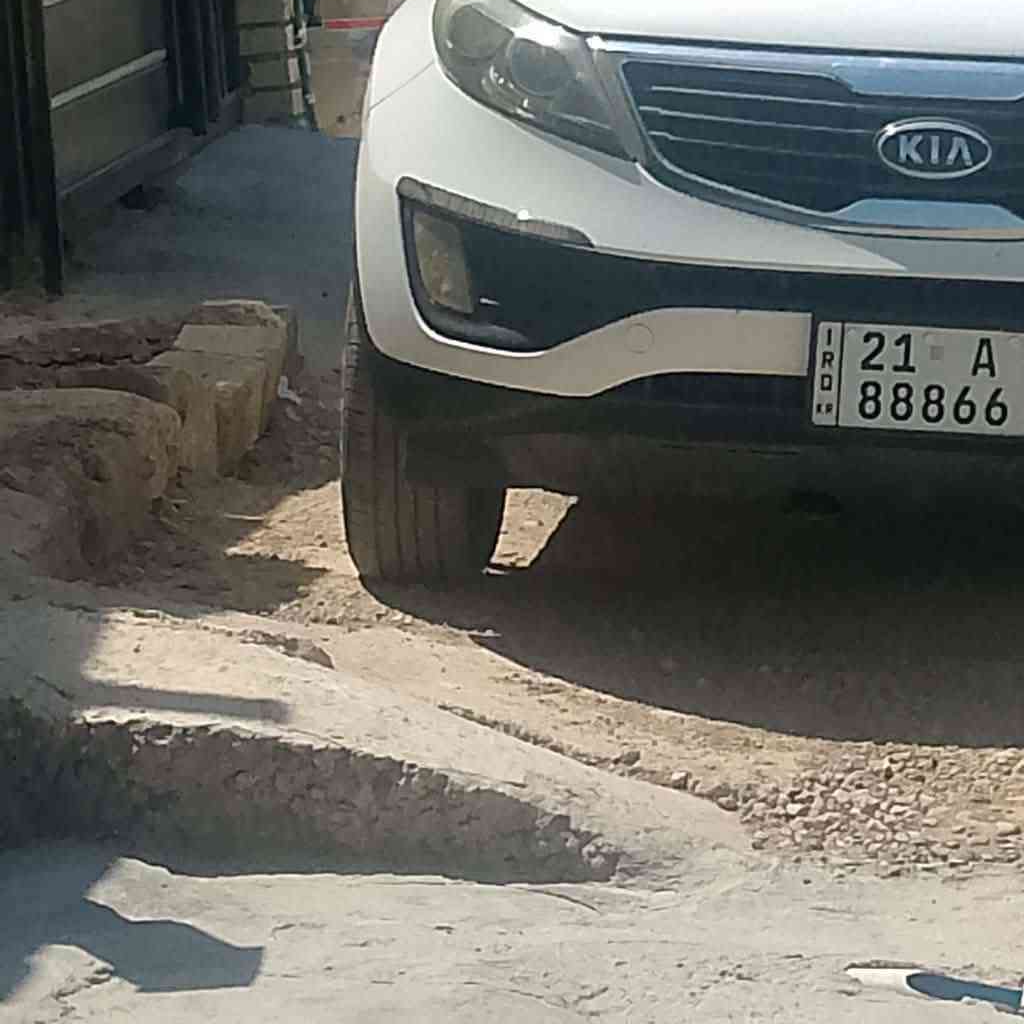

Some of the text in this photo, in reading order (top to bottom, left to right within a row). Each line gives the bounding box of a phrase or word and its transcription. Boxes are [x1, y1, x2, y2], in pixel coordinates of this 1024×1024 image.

[898, 134, 973, 166] KIA
[860, 331, 996, 378] 21 A
[858, 380, 1008, 427] 88866
